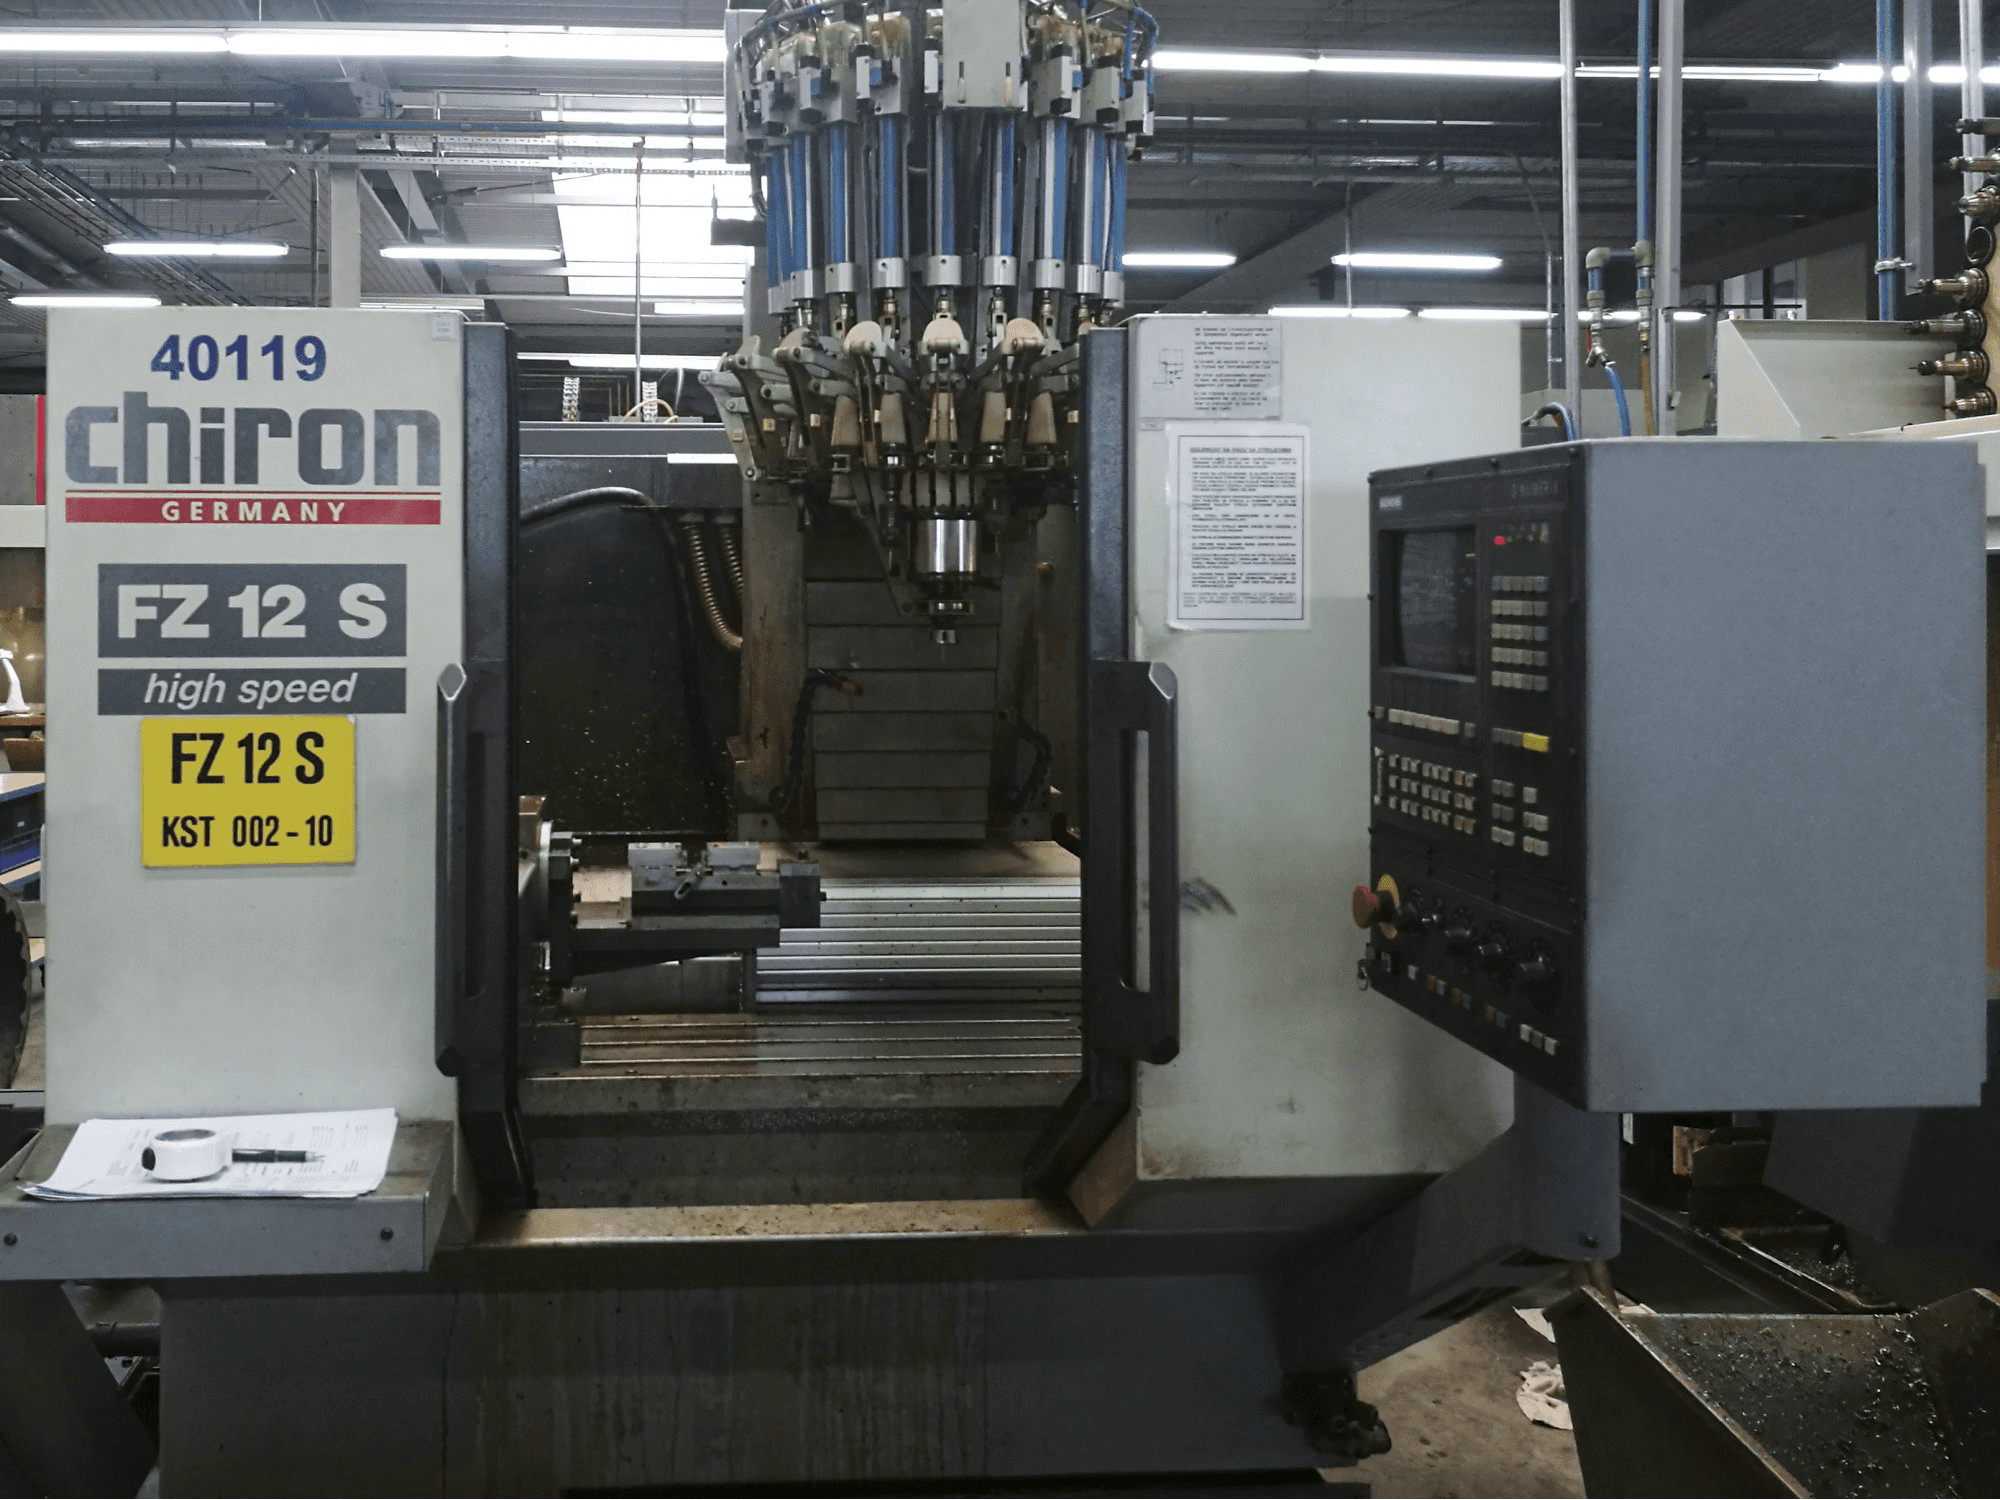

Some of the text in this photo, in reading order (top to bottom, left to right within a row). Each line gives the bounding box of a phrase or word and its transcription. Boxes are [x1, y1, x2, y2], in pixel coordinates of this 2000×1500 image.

[151, 335, 326, 381] 40119
[66, 391, 441, 486] chiron
[162, 500, 346, 521] GERMANY
[118, 583, 388, 638] FZ 12 S
[144, 673, 358, 710] high speed
[171, 732, 324, 784] FZ 12 S
[162, 816, 214, 847] KST
